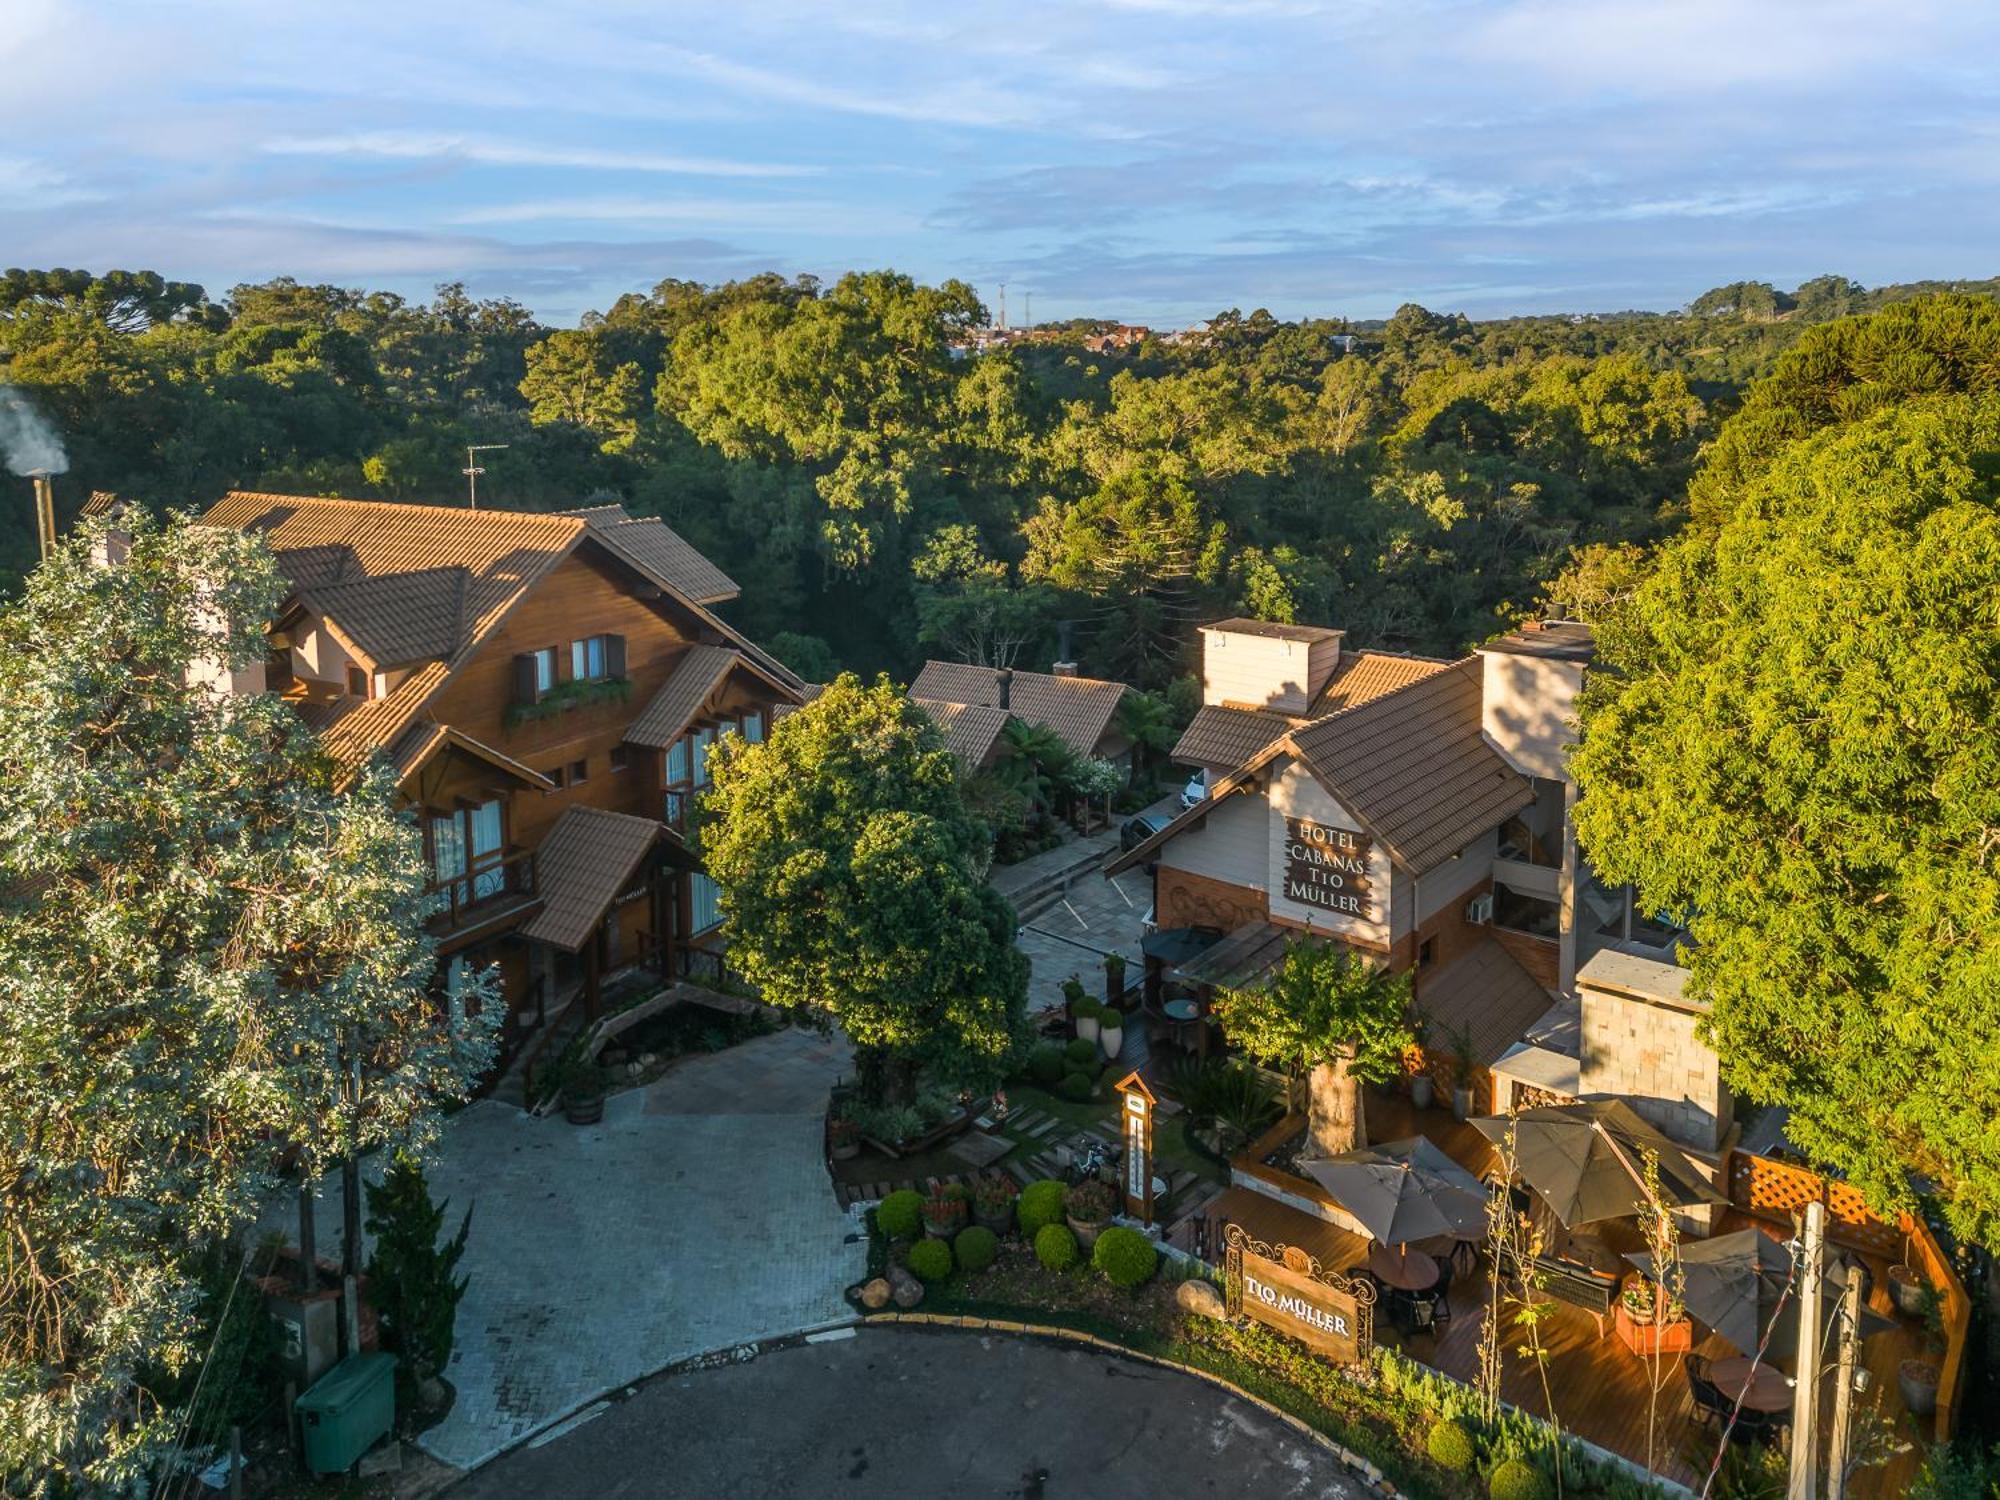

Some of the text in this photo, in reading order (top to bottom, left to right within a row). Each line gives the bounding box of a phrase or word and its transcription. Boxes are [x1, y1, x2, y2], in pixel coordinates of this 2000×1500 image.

[1300, 823, 1357, 850] HOTEL
[1291, 844, 1364, 875] CABANAS
[1308, 867, 1343, 889] TIO
[1290, 881, 1362, 914] MÜLLER
[1245, 1276, 1276, 1302] TIO
